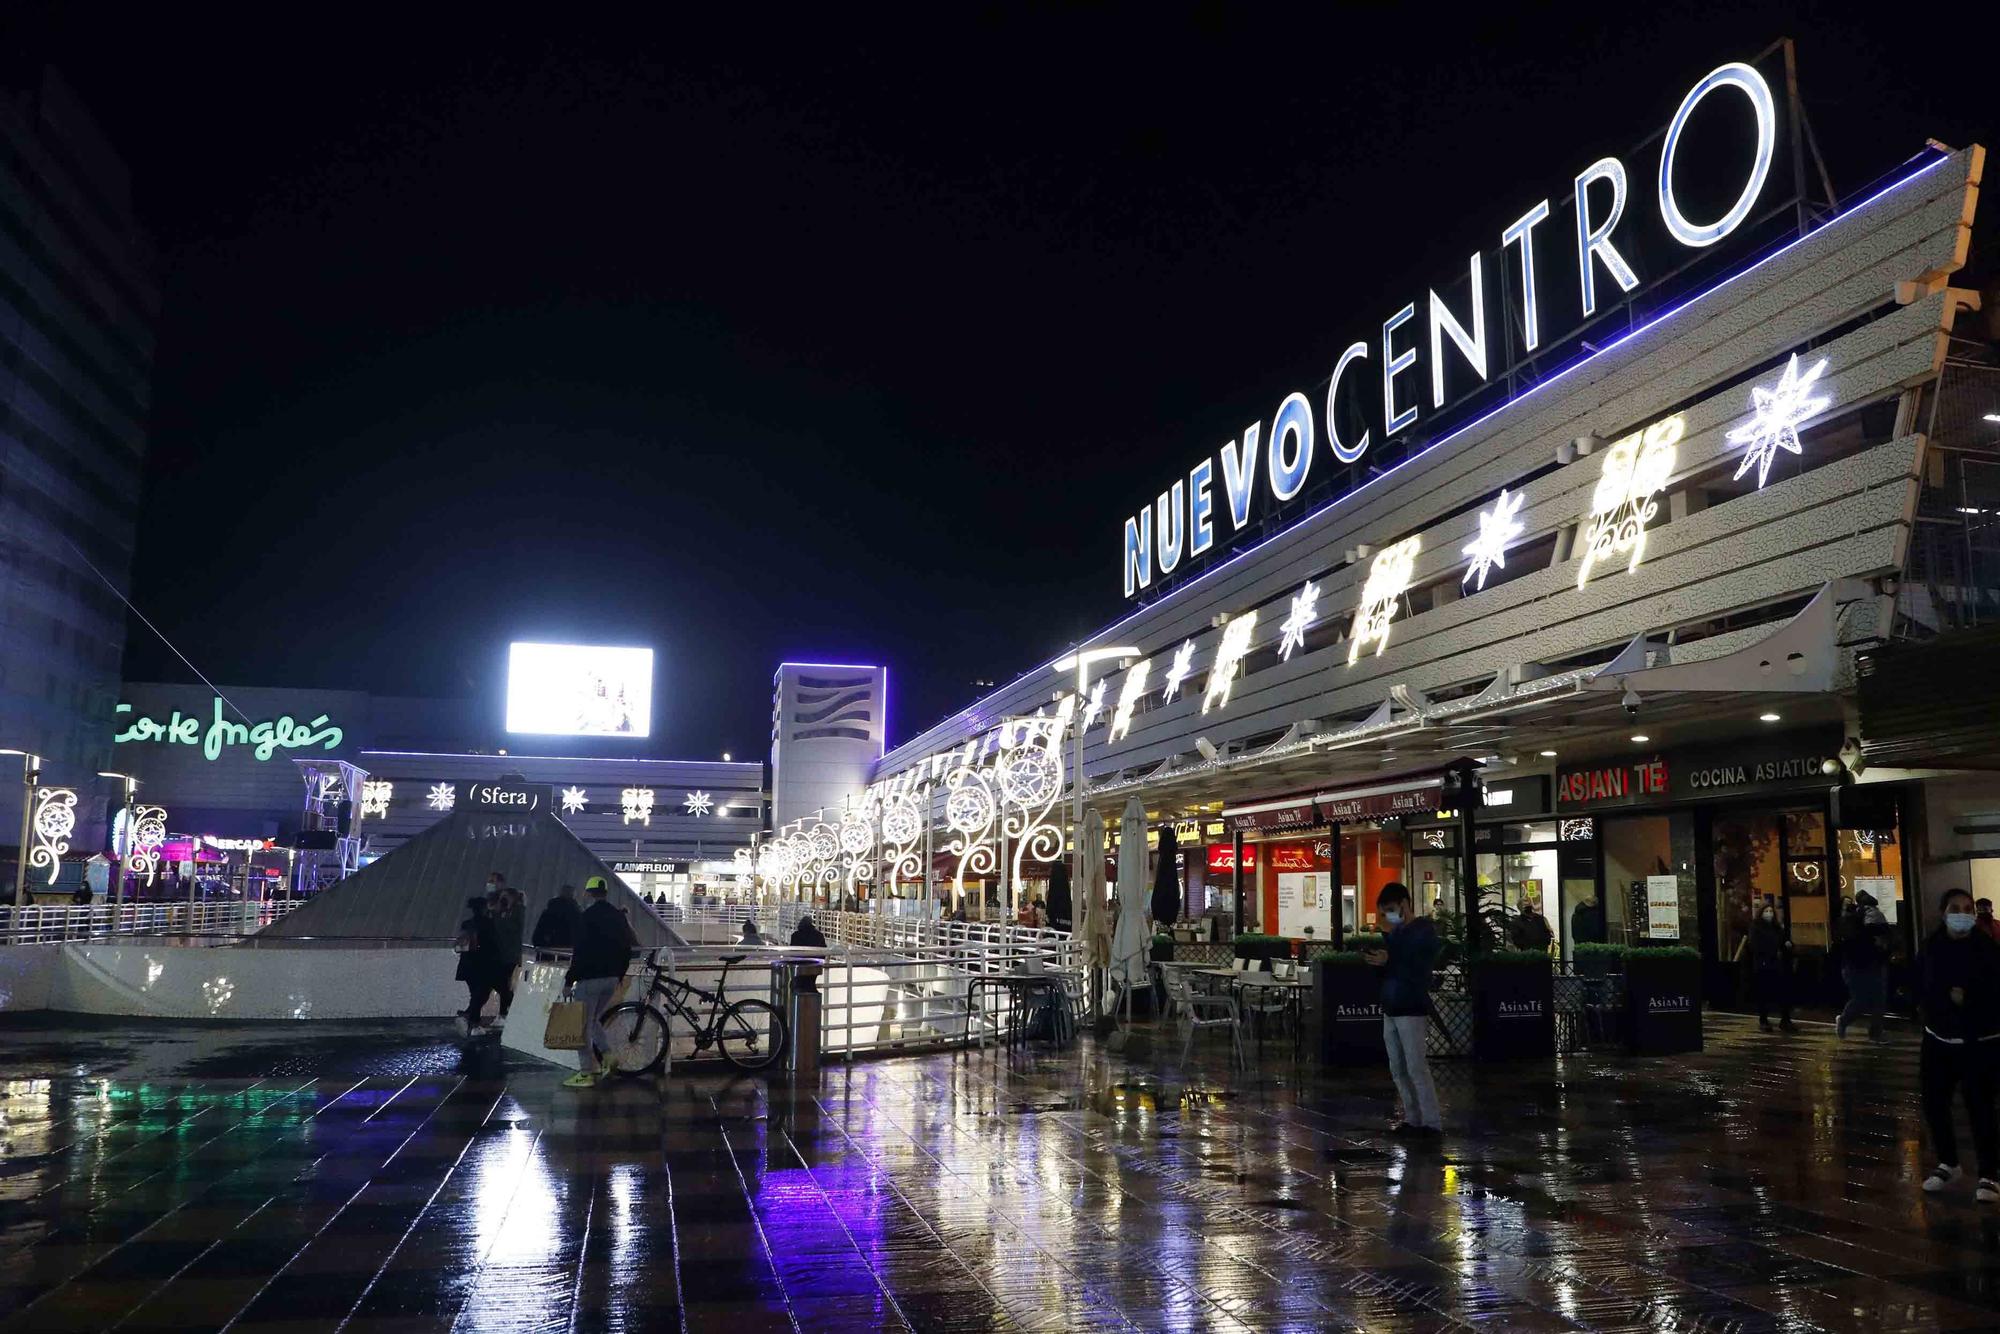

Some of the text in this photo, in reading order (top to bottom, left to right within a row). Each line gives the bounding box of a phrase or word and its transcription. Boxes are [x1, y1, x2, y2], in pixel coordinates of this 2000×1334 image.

[204, 697, 343, 761] Inglés
[1558, 756, 1666, 801] ASIAN TÉ
[1690, 766, 1746, 788] COCINA
[1333, 801, 1361, 816] Asian Té
[1392, 792, 1425, 809] Asian Té
